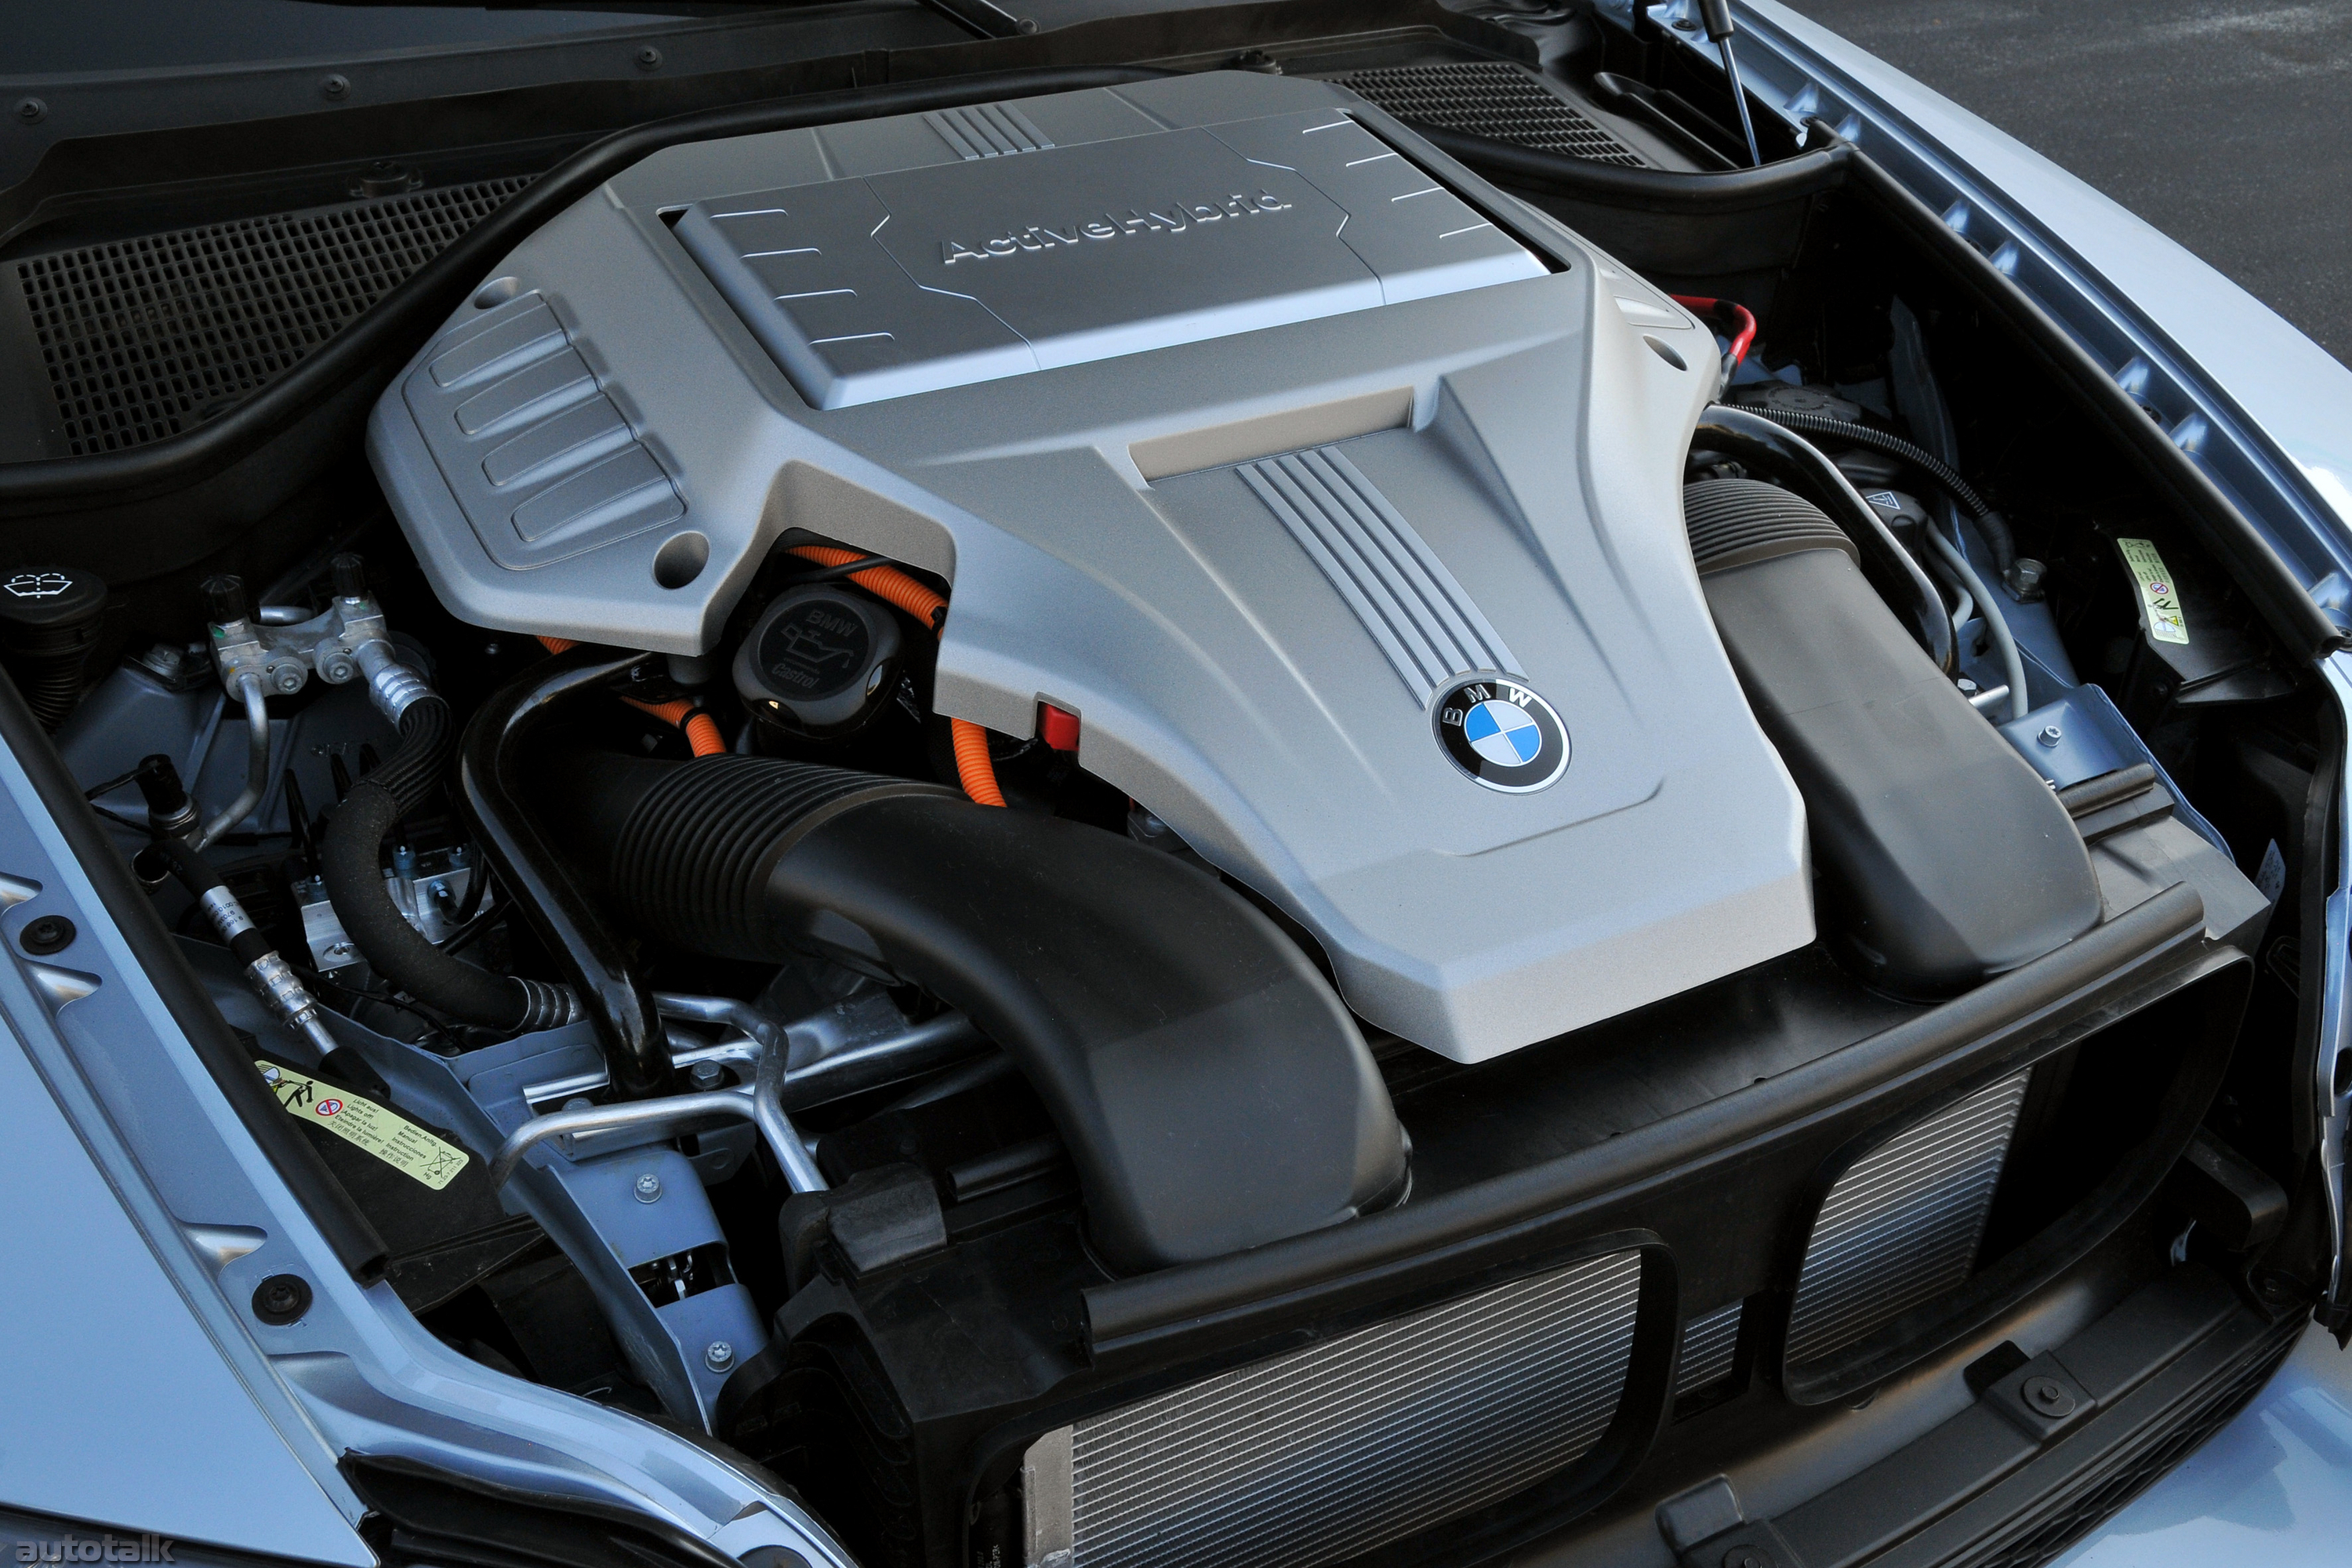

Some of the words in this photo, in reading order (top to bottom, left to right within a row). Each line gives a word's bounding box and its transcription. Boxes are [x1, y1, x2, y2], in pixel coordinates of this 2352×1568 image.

[941, 188, 1292, 263] ActiveHybrid
[806, 609, 858, 637] BMW
[771, 662, 820, 688] Castrol
[1442, 684, 1533, 727] BMW
[347, 1104, 363, 1113] Lights
[353, 1098, 367, 1107] Licht
[335, 1114, 357, 1129] Eteindre
[362, 1130, 384, 1144] lumière!
[367, 1123, 378, 1131] luz!
[397, 1131, 418, 1144] Manual
[386, 1142, 414, 1161] Instruction
[392, 1137, 426, 1159] Instrucciones
[423, 1171, 432, 1180] Hg
